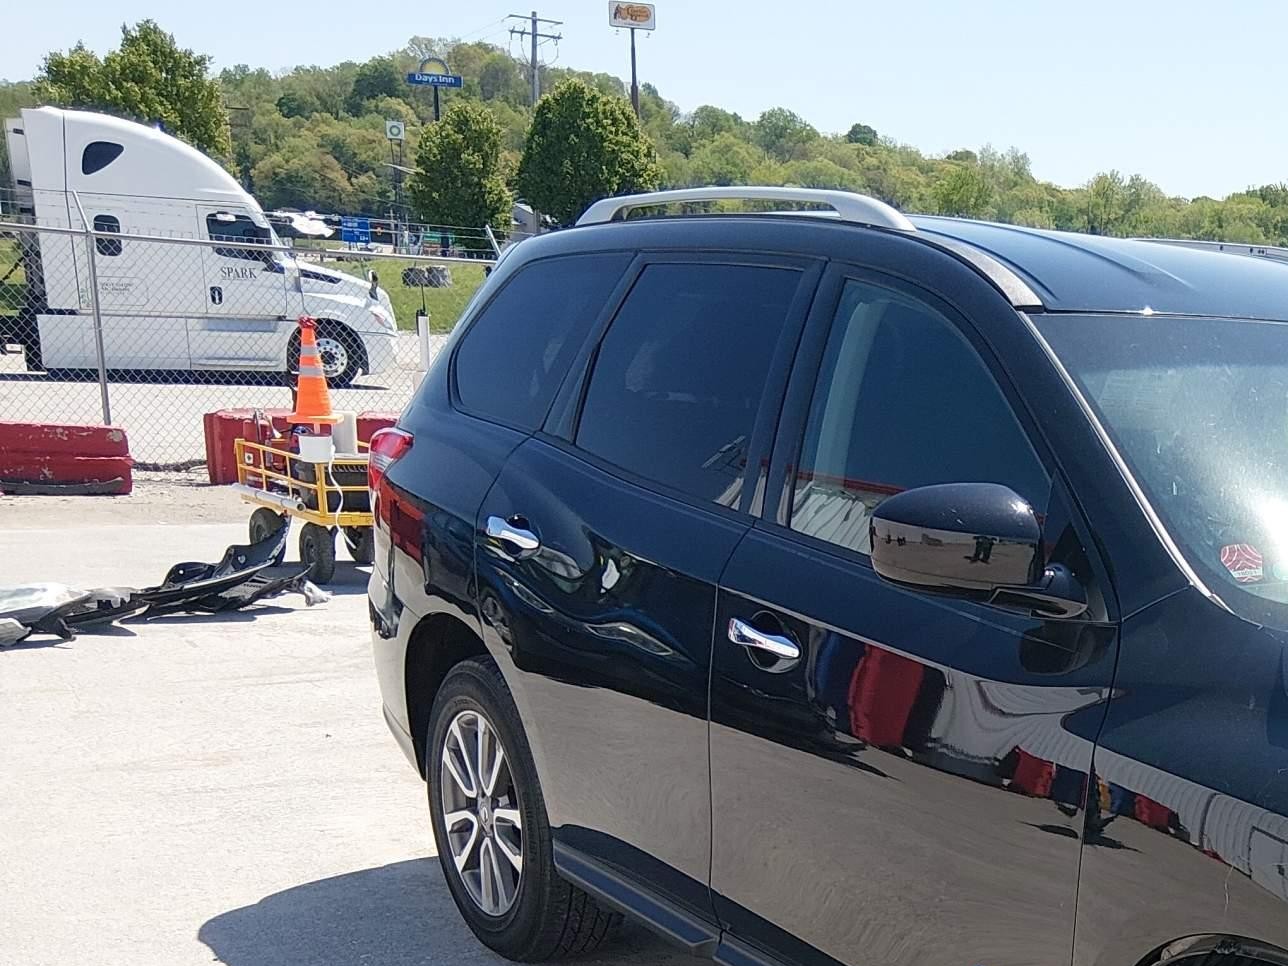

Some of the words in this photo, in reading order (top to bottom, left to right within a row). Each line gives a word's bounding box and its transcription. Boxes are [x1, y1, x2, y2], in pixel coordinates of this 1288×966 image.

[415, 73, 438, 83] Days
[439, 76, 455, 84] Inn
[220, 266, 257, 279] SPARK
